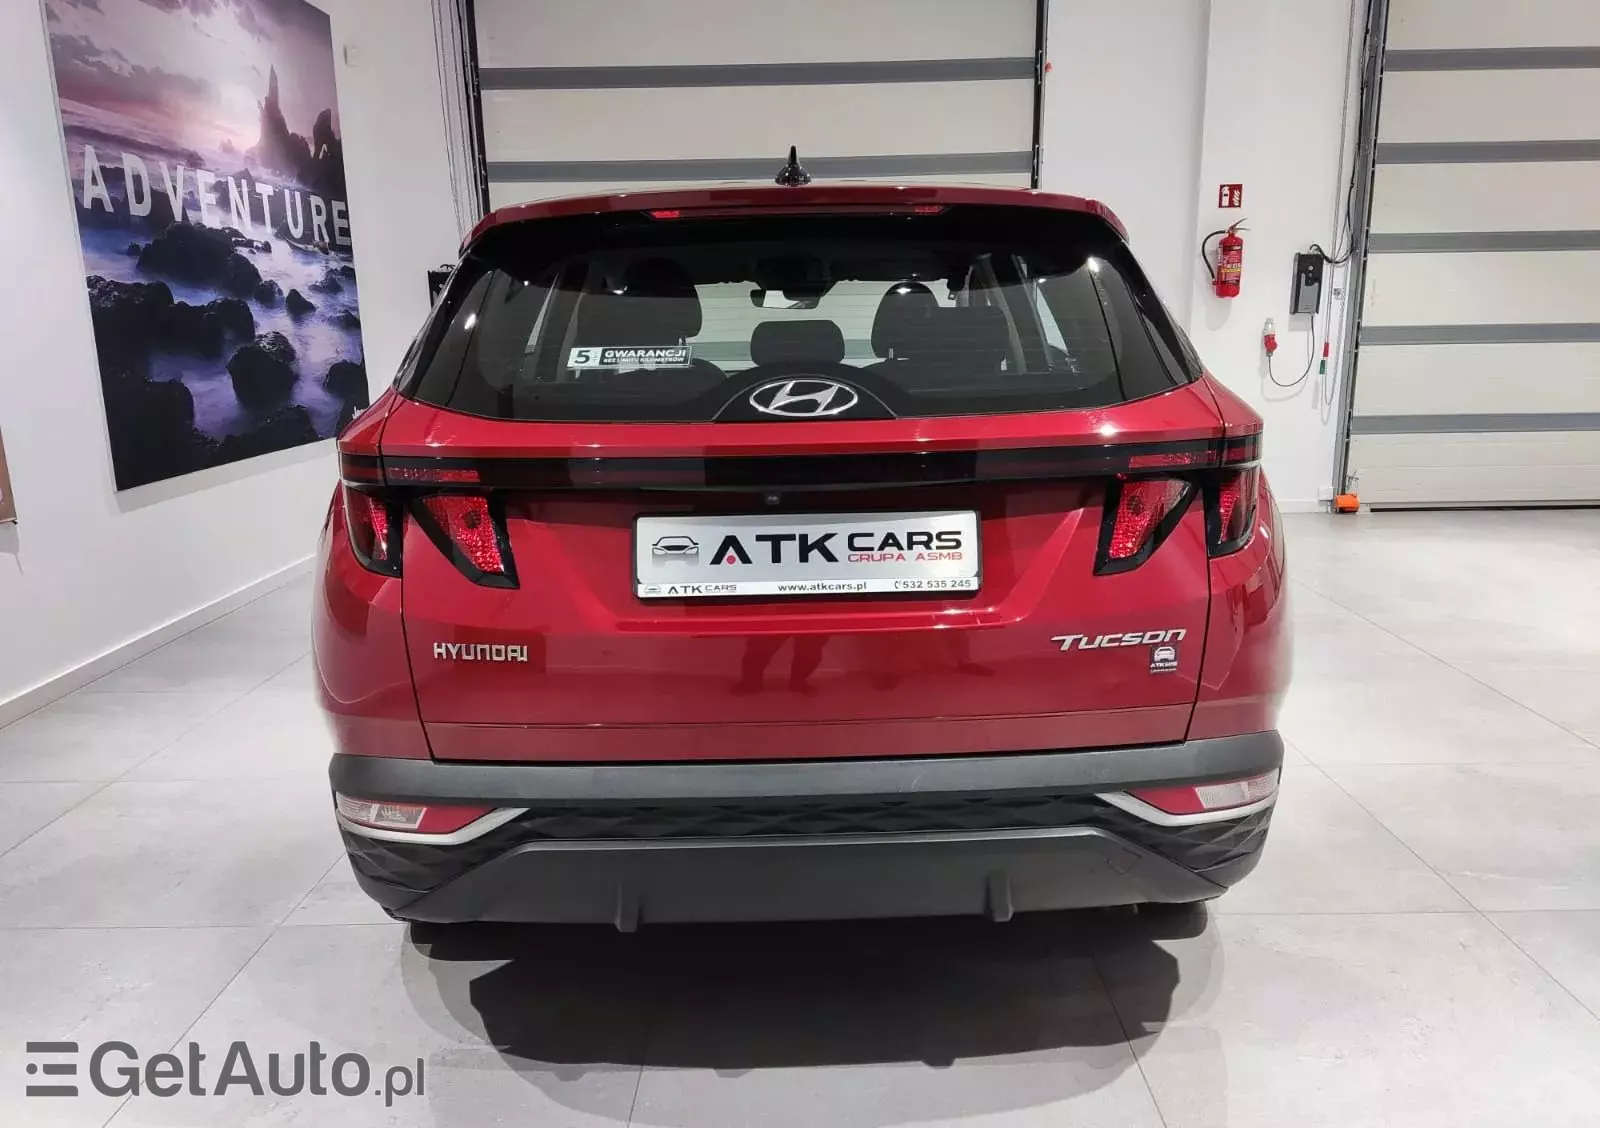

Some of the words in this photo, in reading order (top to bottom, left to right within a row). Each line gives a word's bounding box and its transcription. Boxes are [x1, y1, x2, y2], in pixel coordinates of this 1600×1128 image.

[83, 144, 352, 246] ADVENTURE
[574, 349, 592, 364] 5
[604, 349, 686, 358] GWARANCJI
[709, 533, 839, 565] ATK
[847, 531, 962, 551] CARS
[847, 553, 906, 563] GRUPA
[915, 552, 963, 561] ASMB
[668, 585, 703, 594] ATK
[705, 584, 737, 592] CARS
[778, 582, 867, 593] www.atkcars.pl
[903, 579, 923, 589] 532
[928, 579, 947, 588] 535
[951, 578, 971, 588] 245
[433, 642, 528, 662] HYUNDAI
